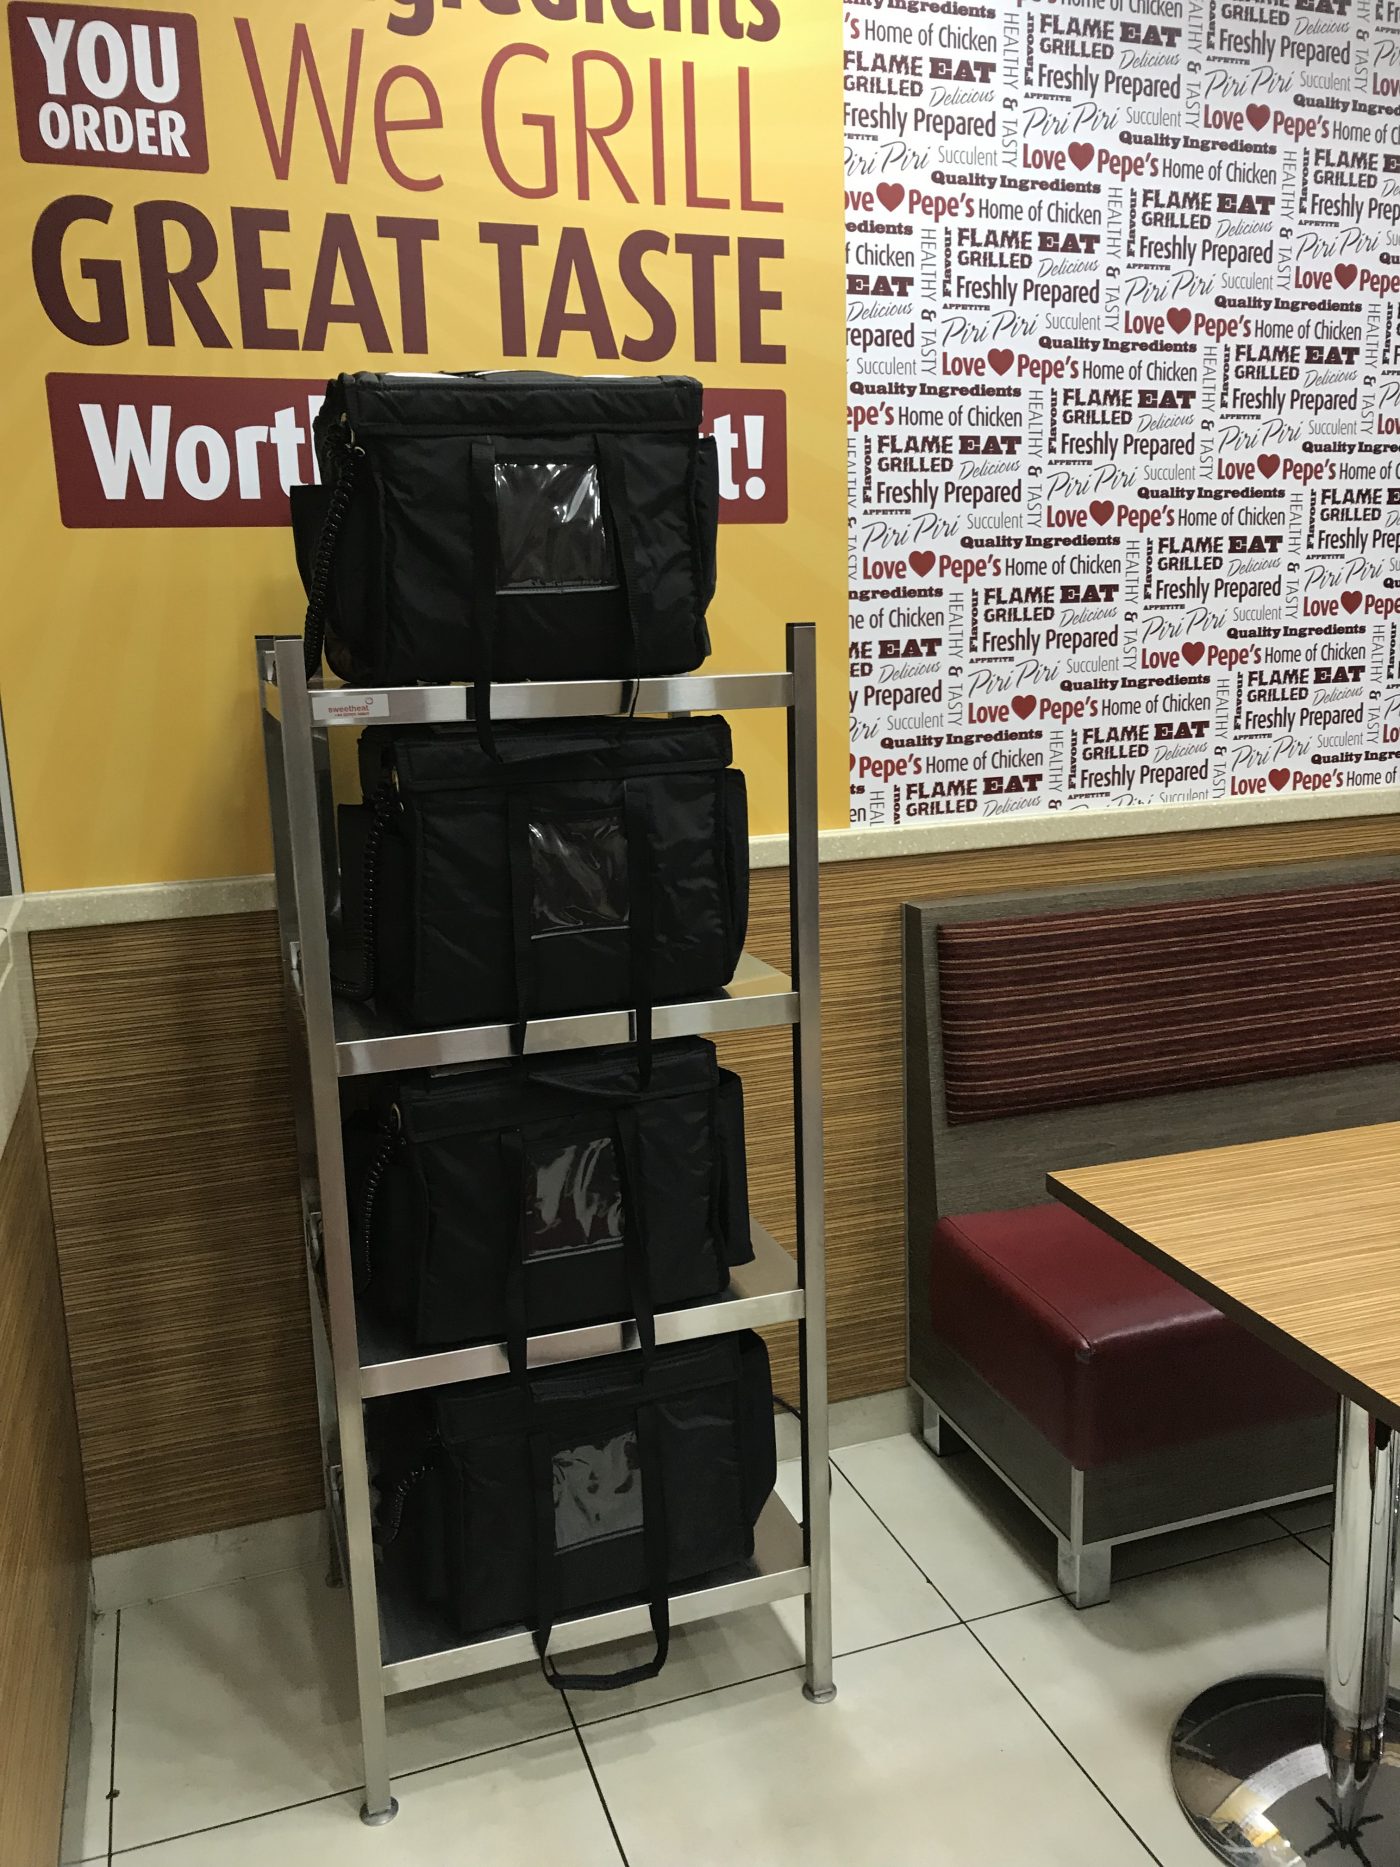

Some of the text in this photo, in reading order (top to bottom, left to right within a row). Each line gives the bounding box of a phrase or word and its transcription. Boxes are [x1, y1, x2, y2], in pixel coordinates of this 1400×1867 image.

[1221, 2, 1289, 26] GRILLED
[1040, 13, 1114, 41] FLAME
[1119, 21, 1182, 48] EAT
[1024, 12, 1034, 86] Flavour
[1040, 37, 1114, 59] GRILLED
[1220, 28, 1350, 67] Freshly Prepared
[28, 17, 180, 104] YOU
[843, 50, 923, 77] FLAME
[929, 57, 996, 83] EAT
[1002, 13, 1019, 167] HEALTHY & TASTY
[1205, 66, 1294, 99] Piri Piri
[1301, 71, 1350, 91] Succulent
[929, 86, 994, 107] Delicious
[1024, 92, 1071, 102] APPETITE
[235, 17, 784, 212] We GRILL
[844, 102, 996, 141] Freshly Prepared
[1127, 107, 1181, 127] Succulent
[1204, 104, 1388, 144] Love Pepe's Home of
[38, 102, 191, 158] ORDER
[1119, 131, 1277, 155] Quality Ingredients
[939, 146, 997, 166] Succulent
[1314, 148, 1378, 171] FLAME
[931, 170, 1101, 194] Quality Ingredients
[1142, 188, 1212, 211] FLAME
[1127, 188, 1137, 257] Flavour
[1277, 151, 1297, 290] HEALTHY & TASTY
[958, 227, 1032, 250] FLAME
[1038, 231, 1100, 254] EAT
[1296, 227, 1381, 261] Piri Piri
[957, 250, 1033, 269] GRILLED
[1140, 234, 1273, 268] Freshly Prepared
[32, 195, 787, 364] GREAT TASTE
[1038, 258, 1098, 278] Delicious
[957, 274, 1100, 308] Freshly Prepared
[1125, 270, 1216, 306] Piri Piri
[847, 301, 912, 321] Delicious
[942, 303, 990, 311] APPETITE
[1046, 312, 1100, 330] Succulent
[1124, 310, 1362, 343] Love Pepe's Home of Chicken
[1382, 302, 1393, 365] Flavour
[1235, 344, 1300, 363] FLAME
[857, 357, 916, 375] Succulent
[1220, 344, 1231, 408] Flavour
[1234, 365, 1300, 381] GRILLED
[1361, 304, 1381, 434] HEALTHY & TASTY
[850, 381, 1022, 398] Quality Ingredients
[1063, 388, 1133, 407] FLAME
[1137, 389, 1196, 409] EAT
[1137, 413, 1194, 432] Delicious
[1309, 419, 1357, 435] Succulent
[959, 435, 1022, 455] EAT
[1061, 431, 1195, 461] Freshly Prepared
[877, 457, 954, 472] GRILLED
[1027, 390, 1043, 528] HEALTHY & TASTY
[1047, 464, 1138, 501] Piri Piri
[1144, 464, 1195, 480] Succulent
[1137, 487, 1285, 500] Quality Ingredients
[1321, 488, 1382, 505] FLAME
[967, 512, 1023, 529] Succulent
[1047, 505, 1285, 533] Love Pepe's Home of Chicken
[1306, 488, 1317, 549] Flavour
[862, 513, 960, 552] Piri Piri
[1157, 556, 1223, 571] GRILLED
[1227, 558, 1280, 577] Delicious
[1304, 557, 1385, 592] Piri Piri
[984, 586, 1055, 605] FLAME
[1060, 584, 1119, 604] EAT
[1123, 541, 1140, 670] HEALTHY & TASTY
[969, 588, 978, 653] Flavour
[1233, 605, 1282, 621] Succulent
[983, 624, 1118, 656] Freshly Prepared
[1227, 624, 1366, 639] Quality Ingredients
[1141, 642, 1366, 671] Love Pepe's Home of Chicken
[879, 662, 940, 683] Delicious
[968, 659, 1060, 698] Piri Piri
[1060, 674, 1211, 692] Quality Ingredients
[1313, 665, 1366, 684] EAT
[1366, 625, 1385, 743] HEALTHY & TASTY
[1233, 671, 1243, 730] Flavour
[1247, 687, 1309, 702] GRILLED
[887, 712, 943, 730] Succulent
[1245, 702, 1364, 732] Freshly Prepared
[880, 729, 1043, 749] Quality Ingredients
[1083, 724, 1149, 745] FLAME
[1049, 731, 1064, 792] HEALTHY
[1153, 742, 1207, 763] Delicious
[983, 773, 1043, 795] EAT
[1231, 766, 1397, 796] Love Pepe's Home of
[906, 798, 977, 817] GRILLED
